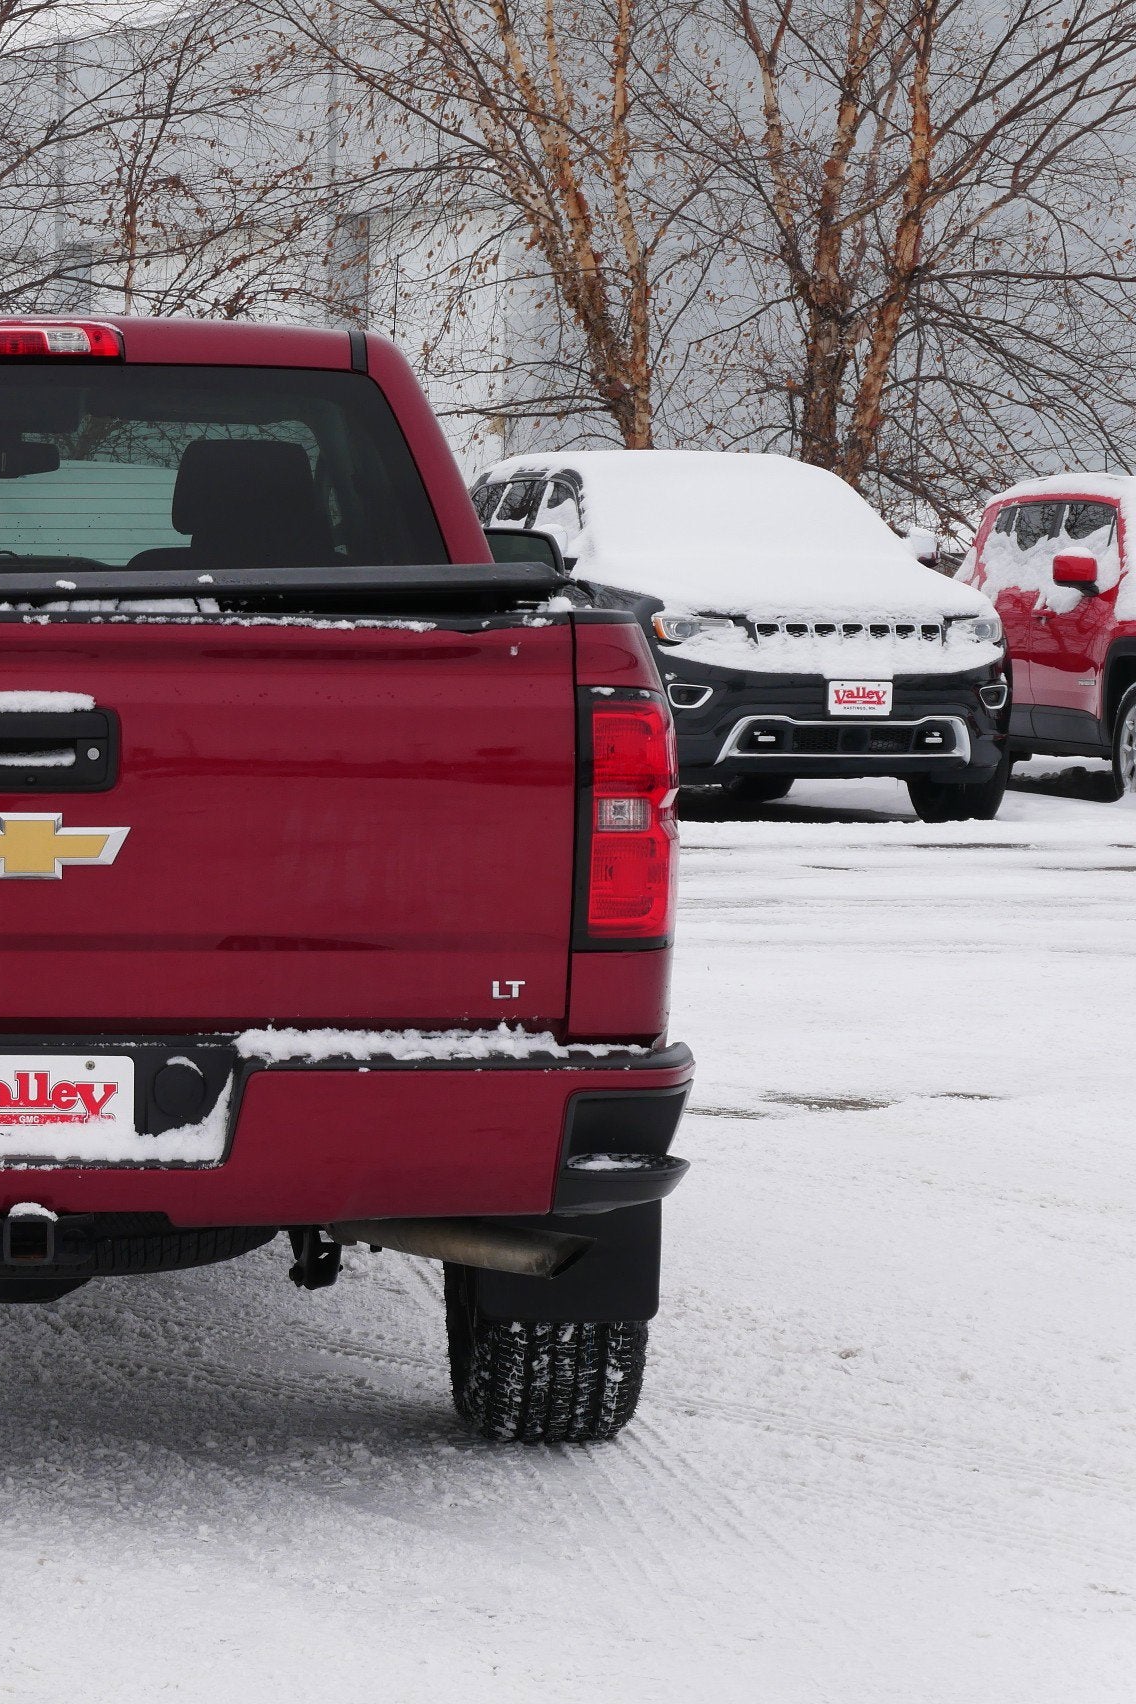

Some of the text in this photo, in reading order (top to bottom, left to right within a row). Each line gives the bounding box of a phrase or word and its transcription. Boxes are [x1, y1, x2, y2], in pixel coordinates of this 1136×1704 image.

[834, 686, 887, 705] Valley
[492, 980, 526, 999] LT
[18, 1115, 40, 1124] GMC
